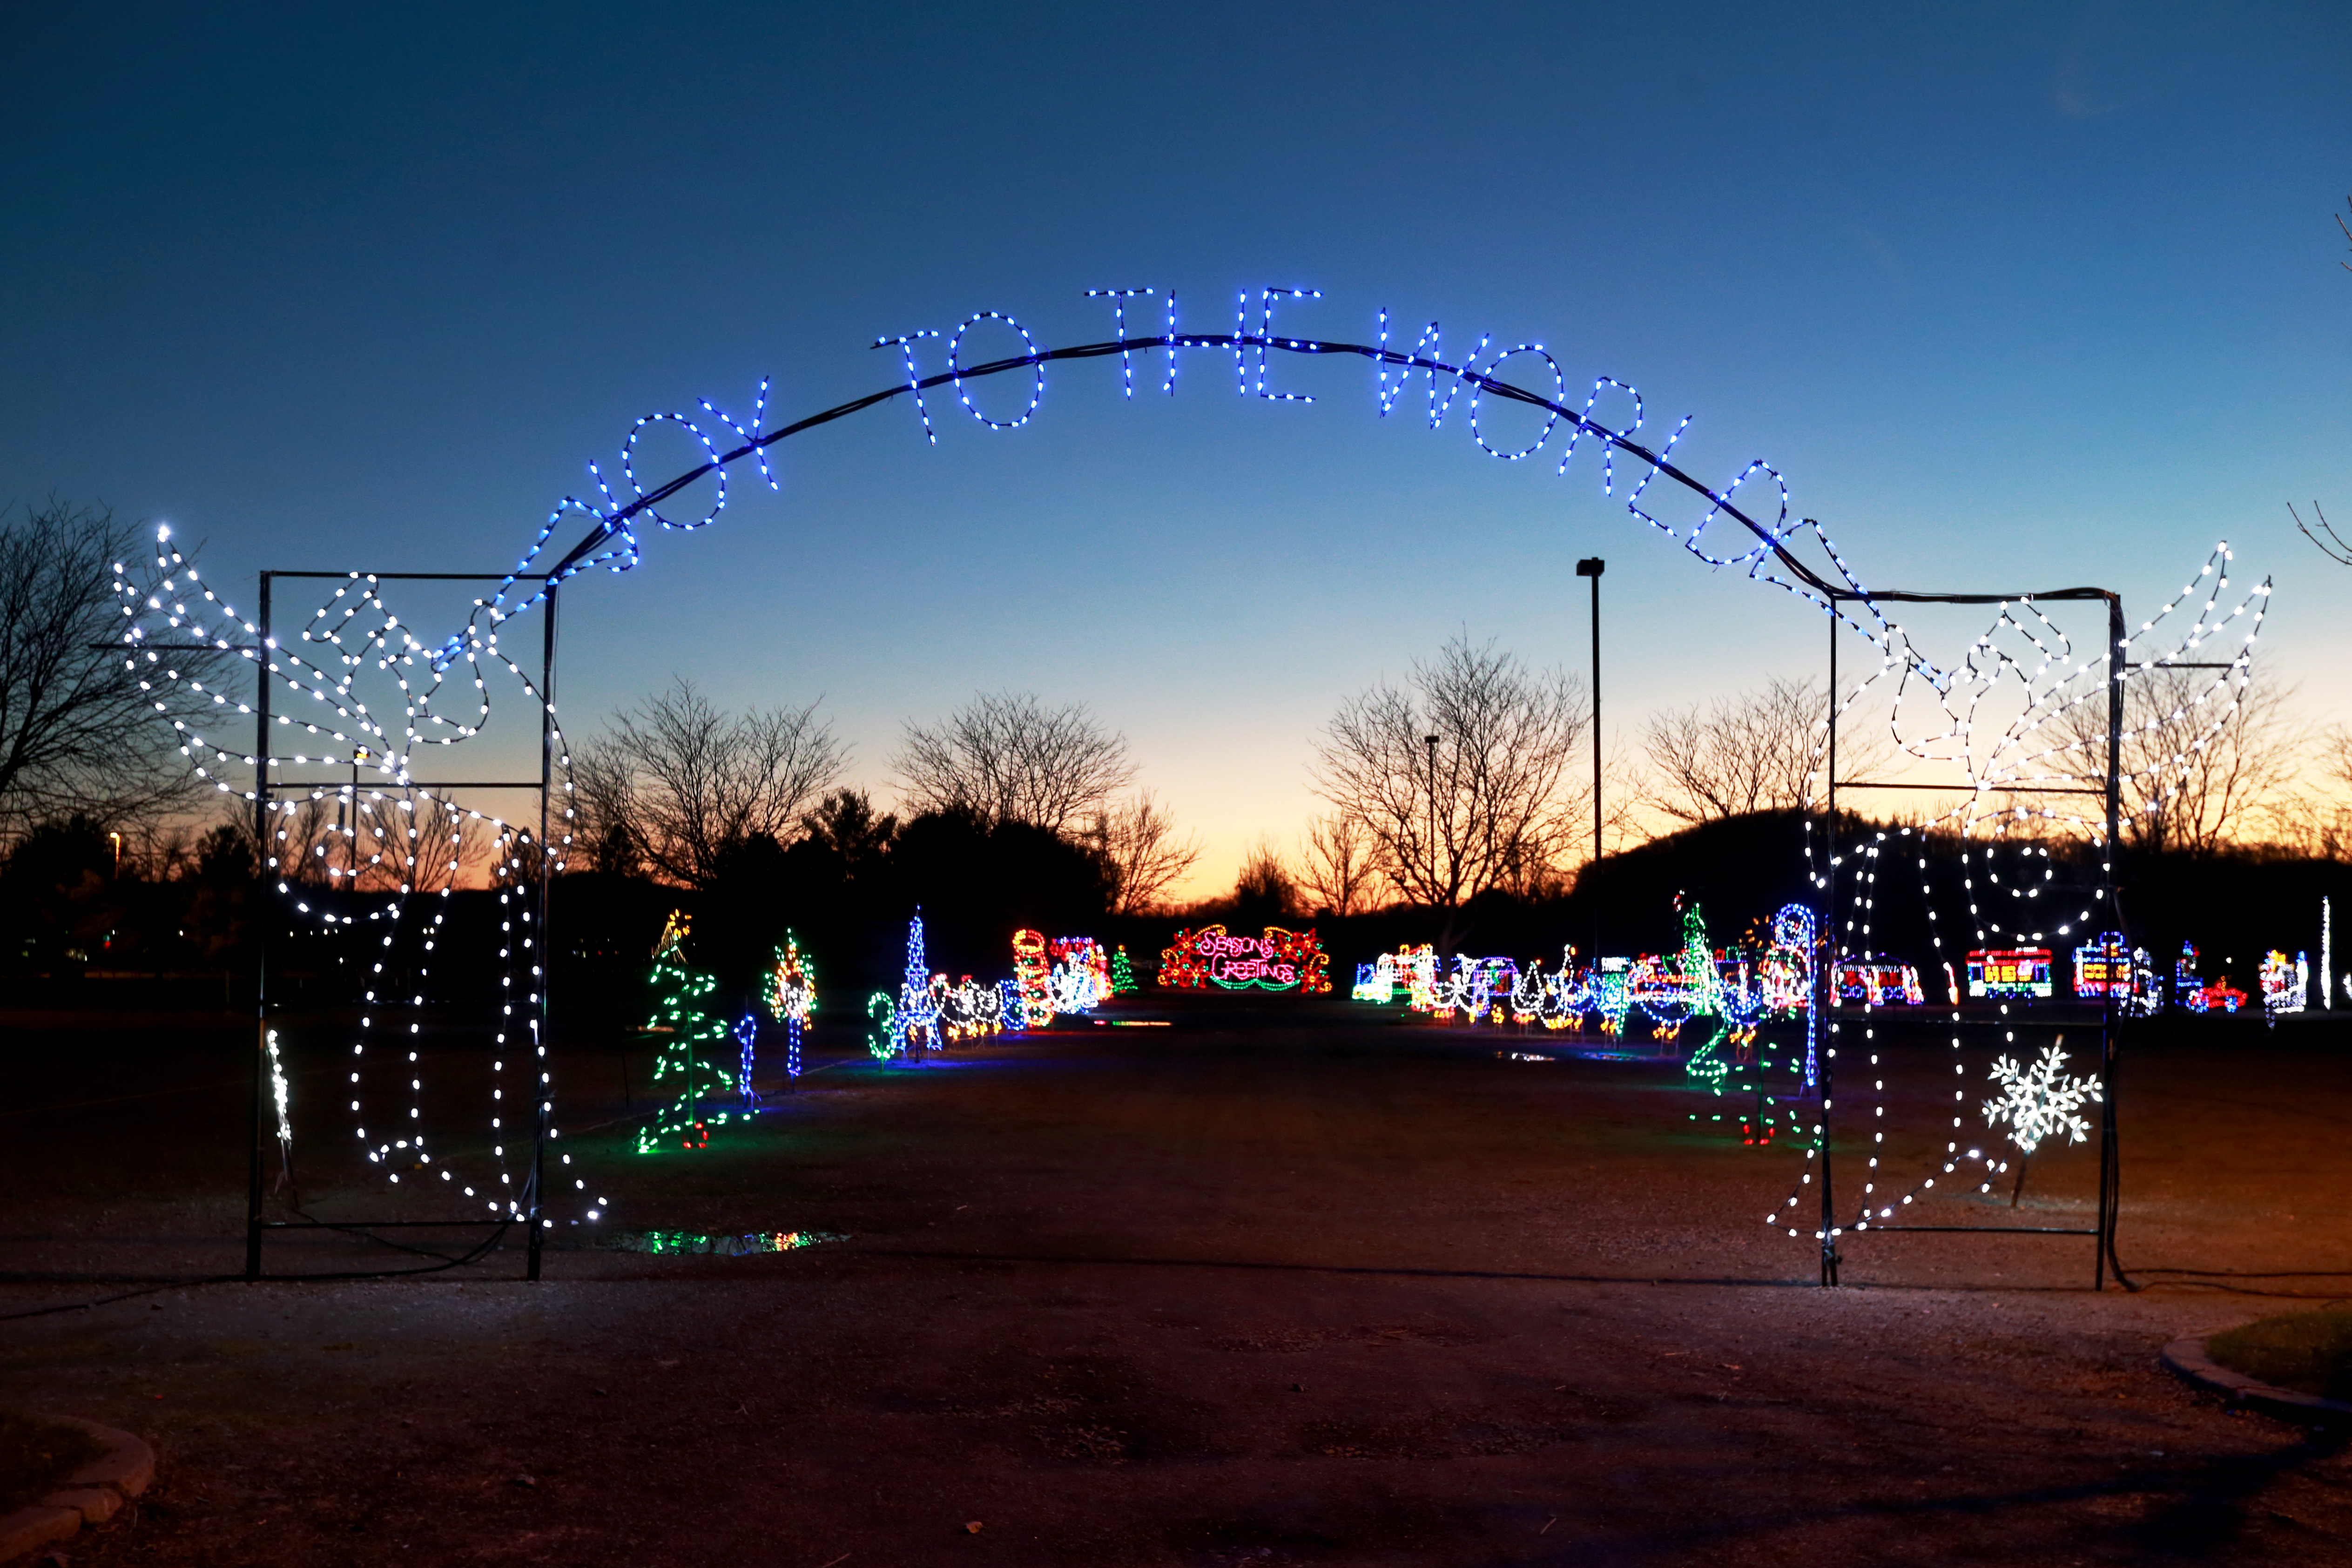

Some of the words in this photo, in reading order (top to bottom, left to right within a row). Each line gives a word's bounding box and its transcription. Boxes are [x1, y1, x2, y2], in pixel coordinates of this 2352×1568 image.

[588, 375, 779, 572] JOY
[869, 310, 1043, 446] TO
[1085, 287, 1323, 403] THE
[1376, 306, 1788, 566] WORLD
[1200, 931, 1275, 959] SEASONS
[1211, 952, 1295, 985] GREETINGS
[868, 991, 896, 1060] 3
